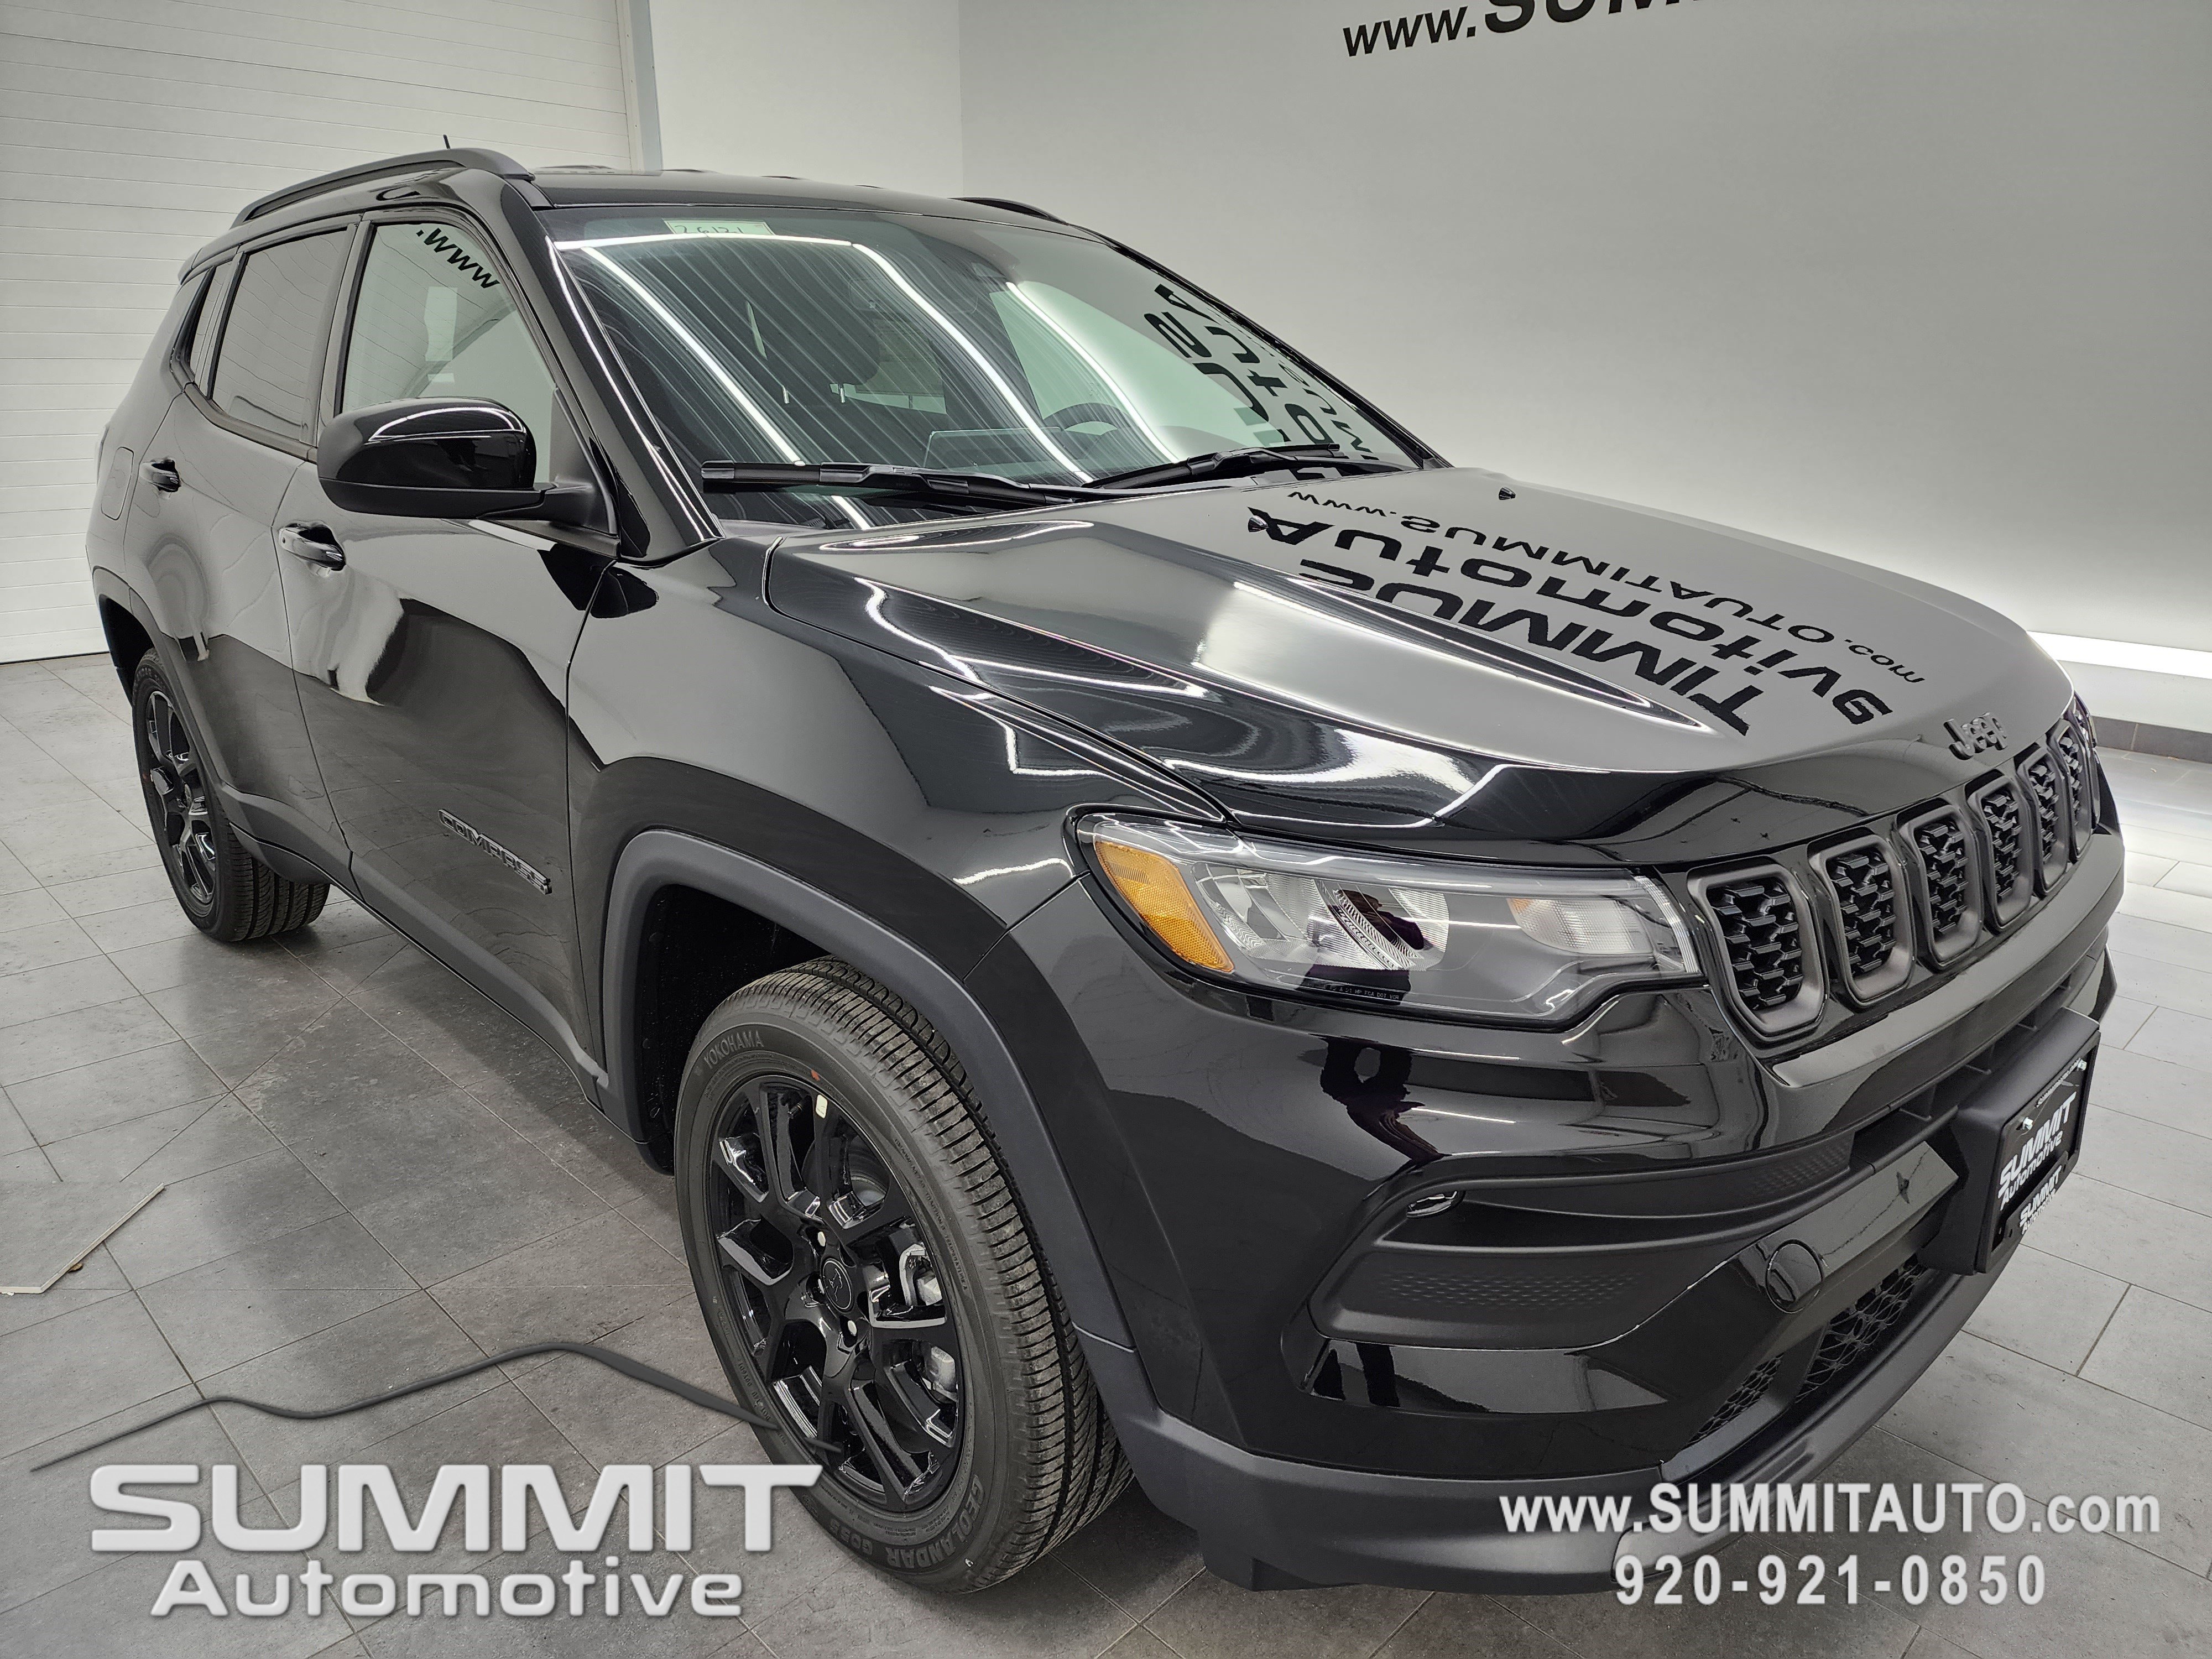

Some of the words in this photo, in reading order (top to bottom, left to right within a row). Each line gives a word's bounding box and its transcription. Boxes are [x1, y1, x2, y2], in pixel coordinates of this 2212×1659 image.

[1943, 712, 2008, 760] Jeep
[704, 1030, 764, 1070] YOKOHAMA
[1998, 1091, 2077, 1199] SUMMIT
[2000, 1130, 2063, 1211] Automotive
[2020, 1165, 2062, 1228] SUMMIT
[885, 1474, 984, 1568] GEOLANDAR
